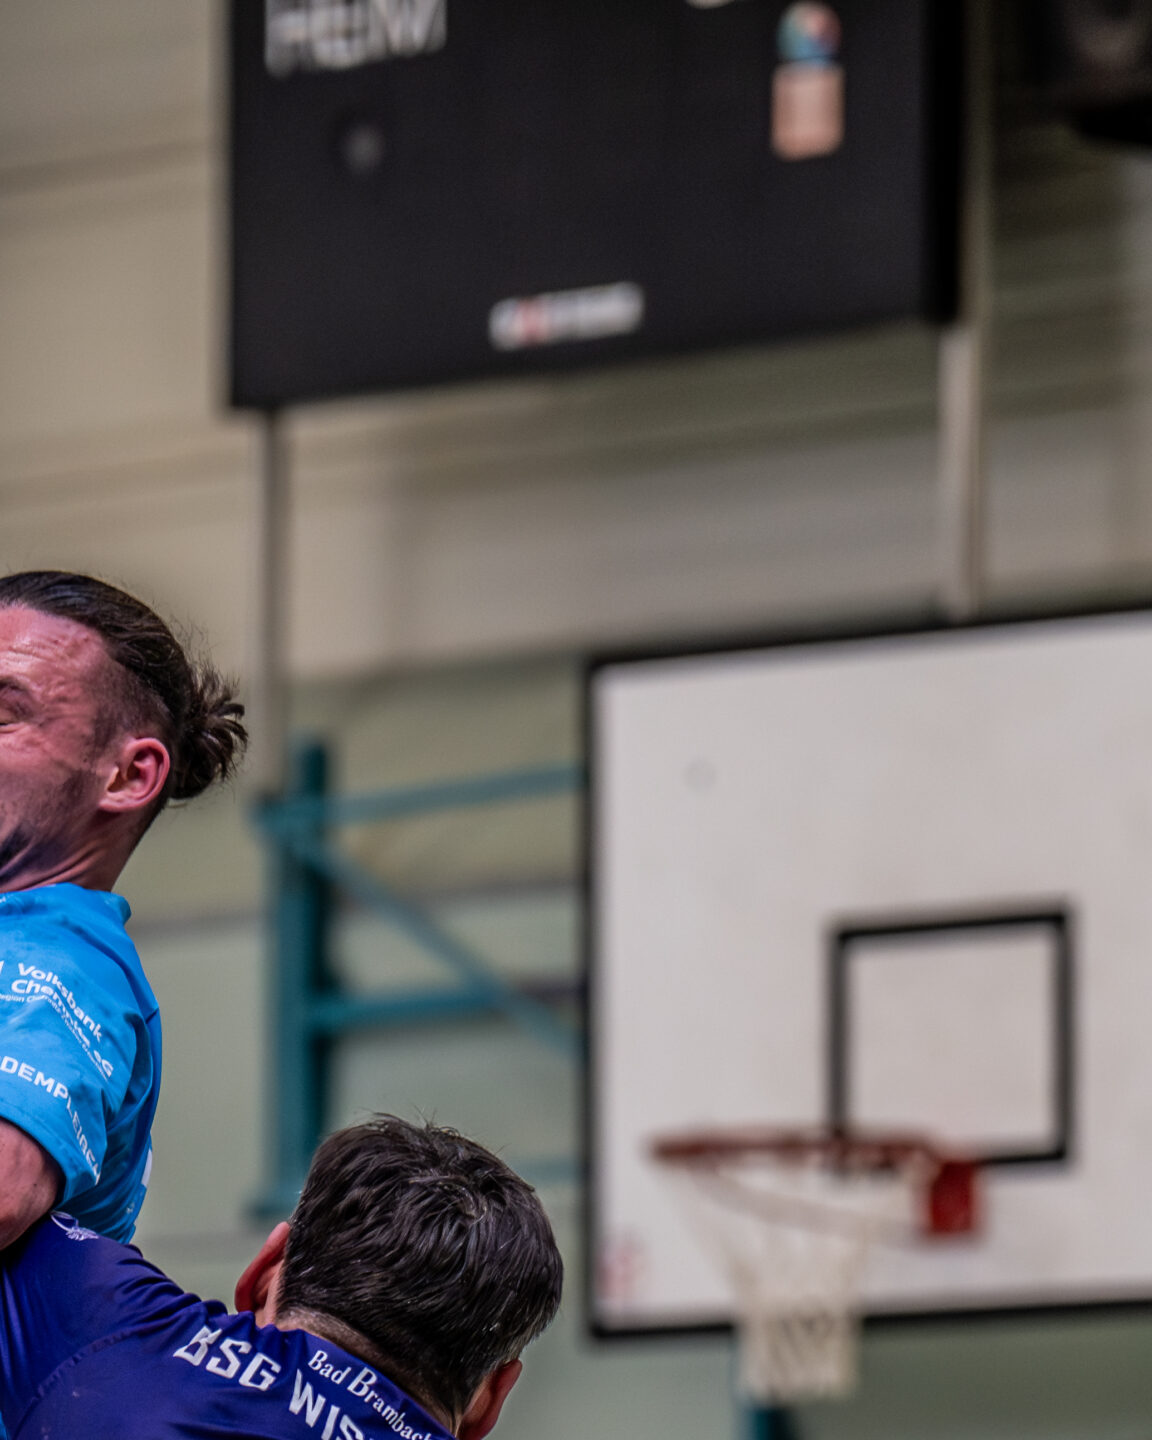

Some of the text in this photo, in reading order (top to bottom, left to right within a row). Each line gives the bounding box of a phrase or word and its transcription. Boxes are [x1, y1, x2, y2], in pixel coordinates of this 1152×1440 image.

[17, 962, 103, 1042] Volksbank
[173, 1325, 281, 1391] BSG
[307, 1350, 352, 1385] Bad
